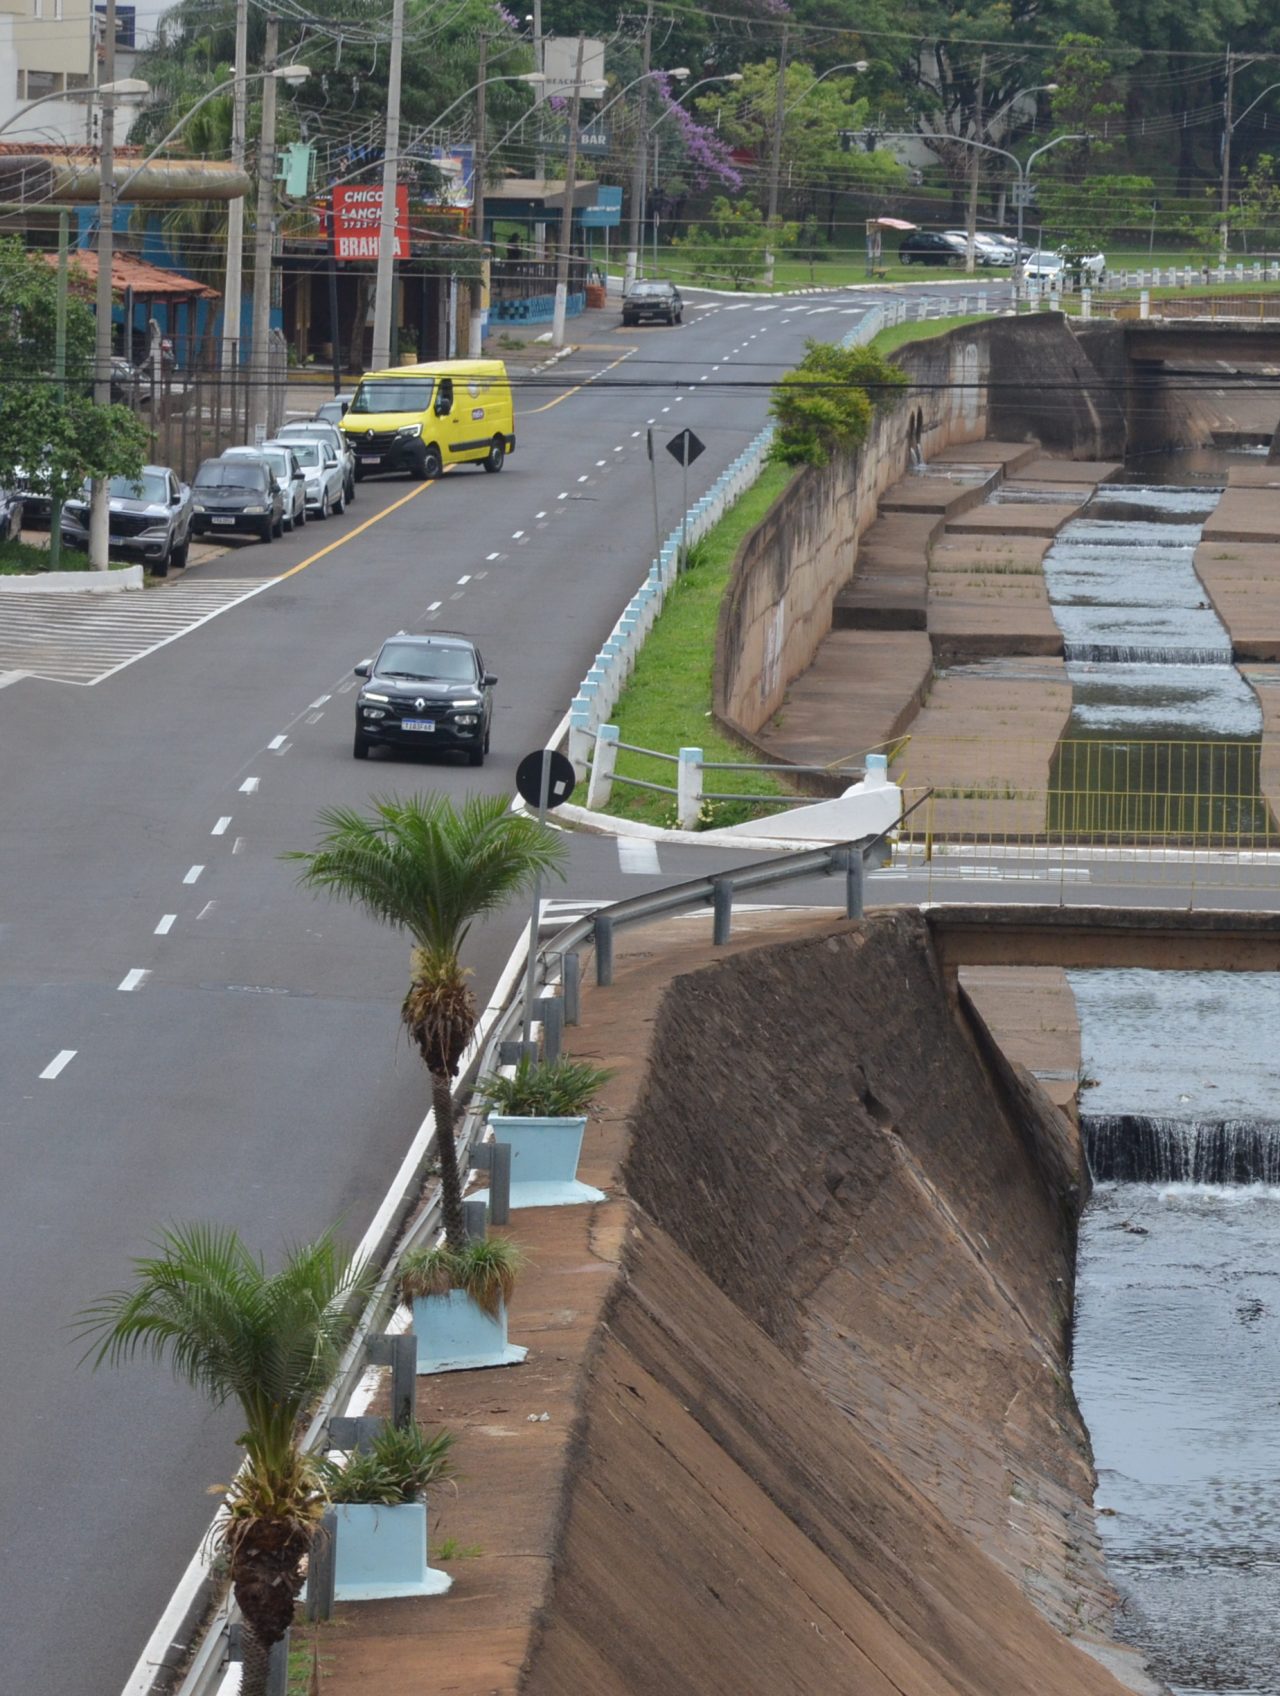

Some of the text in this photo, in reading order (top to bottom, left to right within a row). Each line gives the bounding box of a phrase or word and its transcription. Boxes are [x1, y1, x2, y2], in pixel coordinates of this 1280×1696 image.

[581, 134, 607, 145] BAR
[340, 207, 400, 219] LANCHS
[339, 236, 402, 257] BRAHA
